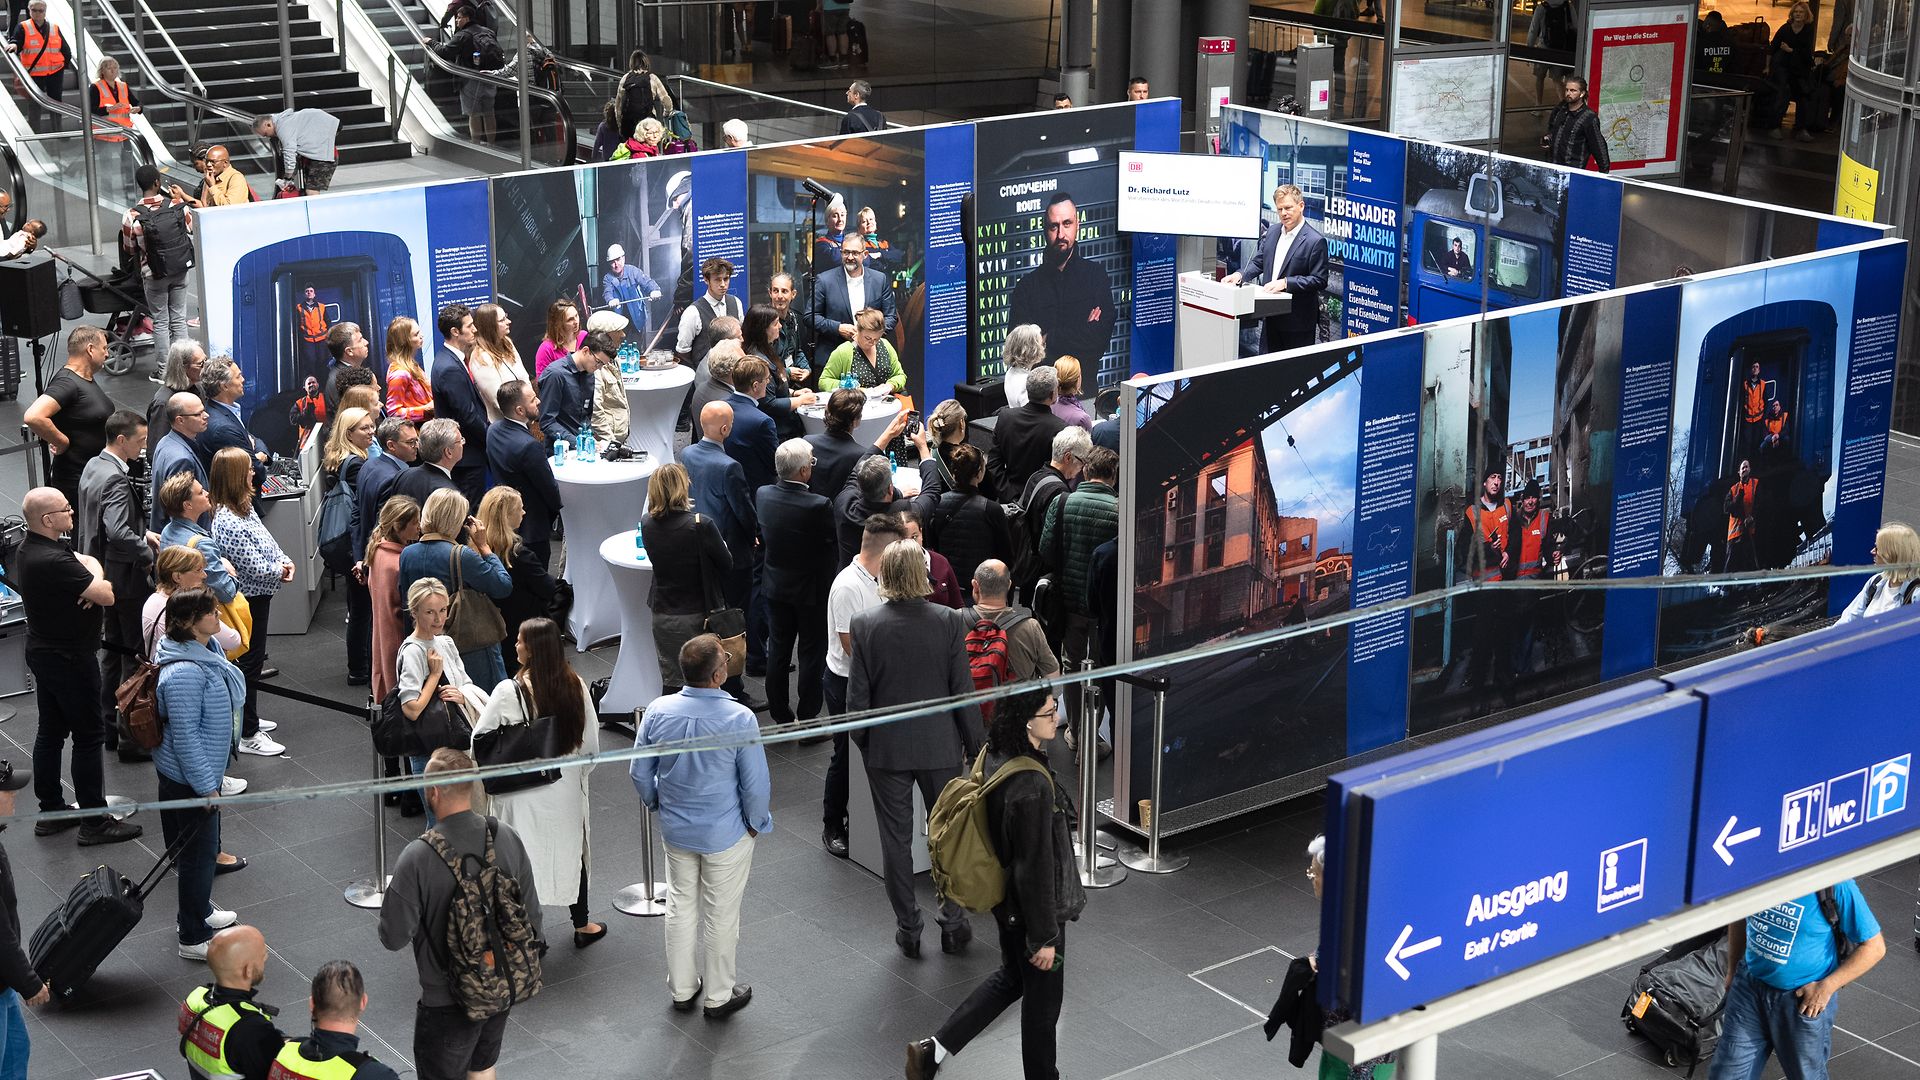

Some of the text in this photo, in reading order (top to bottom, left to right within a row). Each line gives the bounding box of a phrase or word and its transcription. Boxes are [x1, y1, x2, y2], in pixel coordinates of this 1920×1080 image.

[1704, 47, 1730, 56] POLIZEI
[1129, 163, 1142, 171] DB
[1000, 179, 1057, 197] СПОЛУЧЕННЯ
[1141, 187, 1171, 195] Richard
[1172, 188, 1190, 196] Lutz
[1016, 199, 1041, 212] ROUTE
[1325, 196, 1396, 227] LEBENSADER
[978, 222, 1006, 238] KYIV
[1324, 217, 1352, 239] BAHN
[1354, 223, 1395, 248] ЗАЛІЗНА
[978, 241, 1007, 256] KYIV
[1328, 239, 1395, 269] ОРОГА ЖИТТЯ
[979, 258, 1007, 275] KYIV
[979, 276, 1007, 292] KYIV
[1349, 281, 1378, 296] Ukrainische
[980, 294, 1007, 309] KYIV
[1349, 293, 1393, 312] Eisenbahnerinnen
[980, 311, 1007, 326] KYIV
[1348, 307, 1390, 324] und Eisenbahner
[1348, 316, 1354, 326] im
[1355, 319, 1368, 333] Krieg
[980, 327, 1007, 343] KYIV
[981, 345, 1003, 360] KYI
[1877, 775, 1898, 816] P
[1827, 800, 1856, 828] WC
[1465, 871, 1568, 926] Ausgang
[1759, 910, 1795, 929] lieht
[1464, 936, 1491, 961] Exit
[1500, 921, 1538, 948] Sortie
[1756, 934, 1787, 953] Grund
